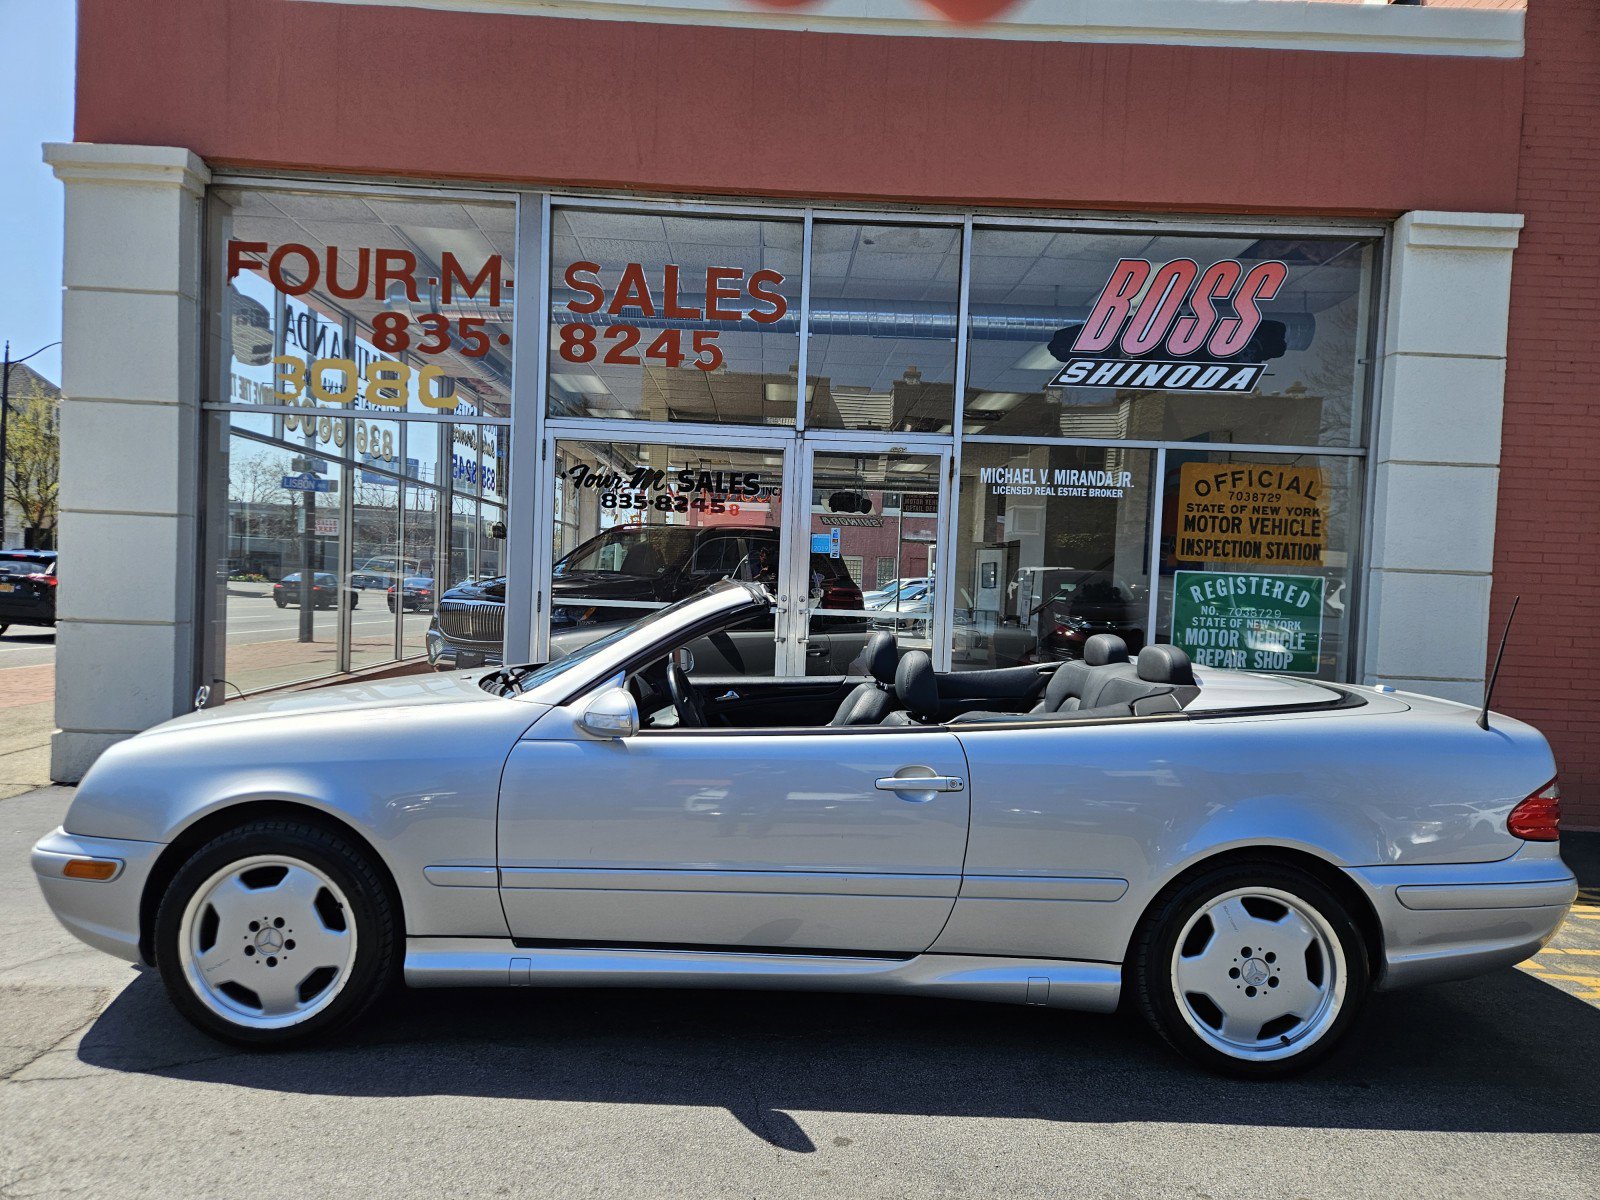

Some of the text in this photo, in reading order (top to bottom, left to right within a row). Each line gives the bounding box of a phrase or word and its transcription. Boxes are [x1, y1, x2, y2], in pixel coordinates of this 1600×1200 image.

[564, 260, 788, 324] SALES
[1070, 257, 1289, 357] BOSS
[559, 322, 724, 372] 8245
[1058, 361, 1258, 390] SHINODA
[283, 478, 316, 490] LISBON
[568, 464, 624, 490] Four
[622, 466, 665, 491] M
[678, 470, 761, 495] SALES
[980, 467, 1135, 488] MICHAEL V. MIRANDA JR.
[1194, 470, 1318, 501] OFFICIAL
[992, 485, 1124, 498] LICENSED REAL ESTATE BROKER
[1228, 491, 1282, 503] 7038729
[1186, 503, 1320, 517] STATE OF NEW YORK
[1184, 515, 1322, 537] MOTOR VEHICLE
[1180, 538, 1322, 561] INSPECTION STATION
[1189, 576, 1311, 608] REGISTERED
[1200, 605, 1282, 619] NO. 7038729
[1191, 616, 1302, 631] STATE OF NEW YORK
[1185, 628, 1307, 650] MOTOR VEHICLE
[1195, 648, 1294, 670] REPAIR SHOP
